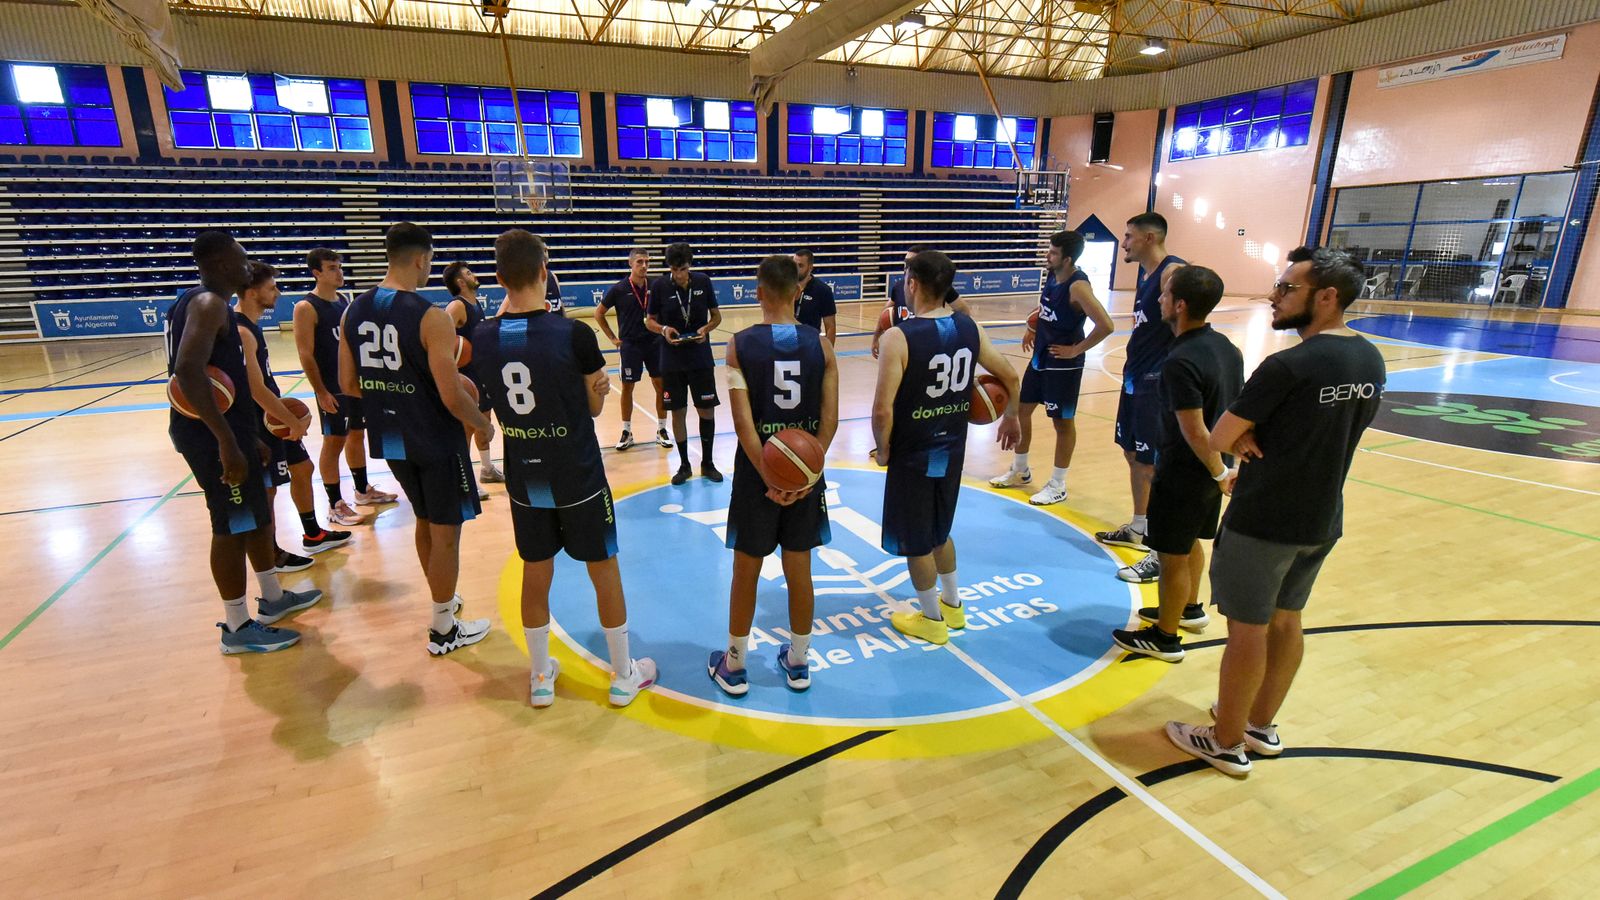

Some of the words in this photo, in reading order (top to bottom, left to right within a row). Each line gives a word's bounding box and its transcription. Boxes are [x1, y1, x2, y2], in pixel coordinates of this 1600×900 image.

[358, 320, 403, 371] 29
[501, 361, 536, 415] 8
[773, 360, 801, 410] 5
[925, 347, 972, 399] 30
[1319, 383, 1375, 405] BEMO
[911, 399, 970, 420] damex.io
